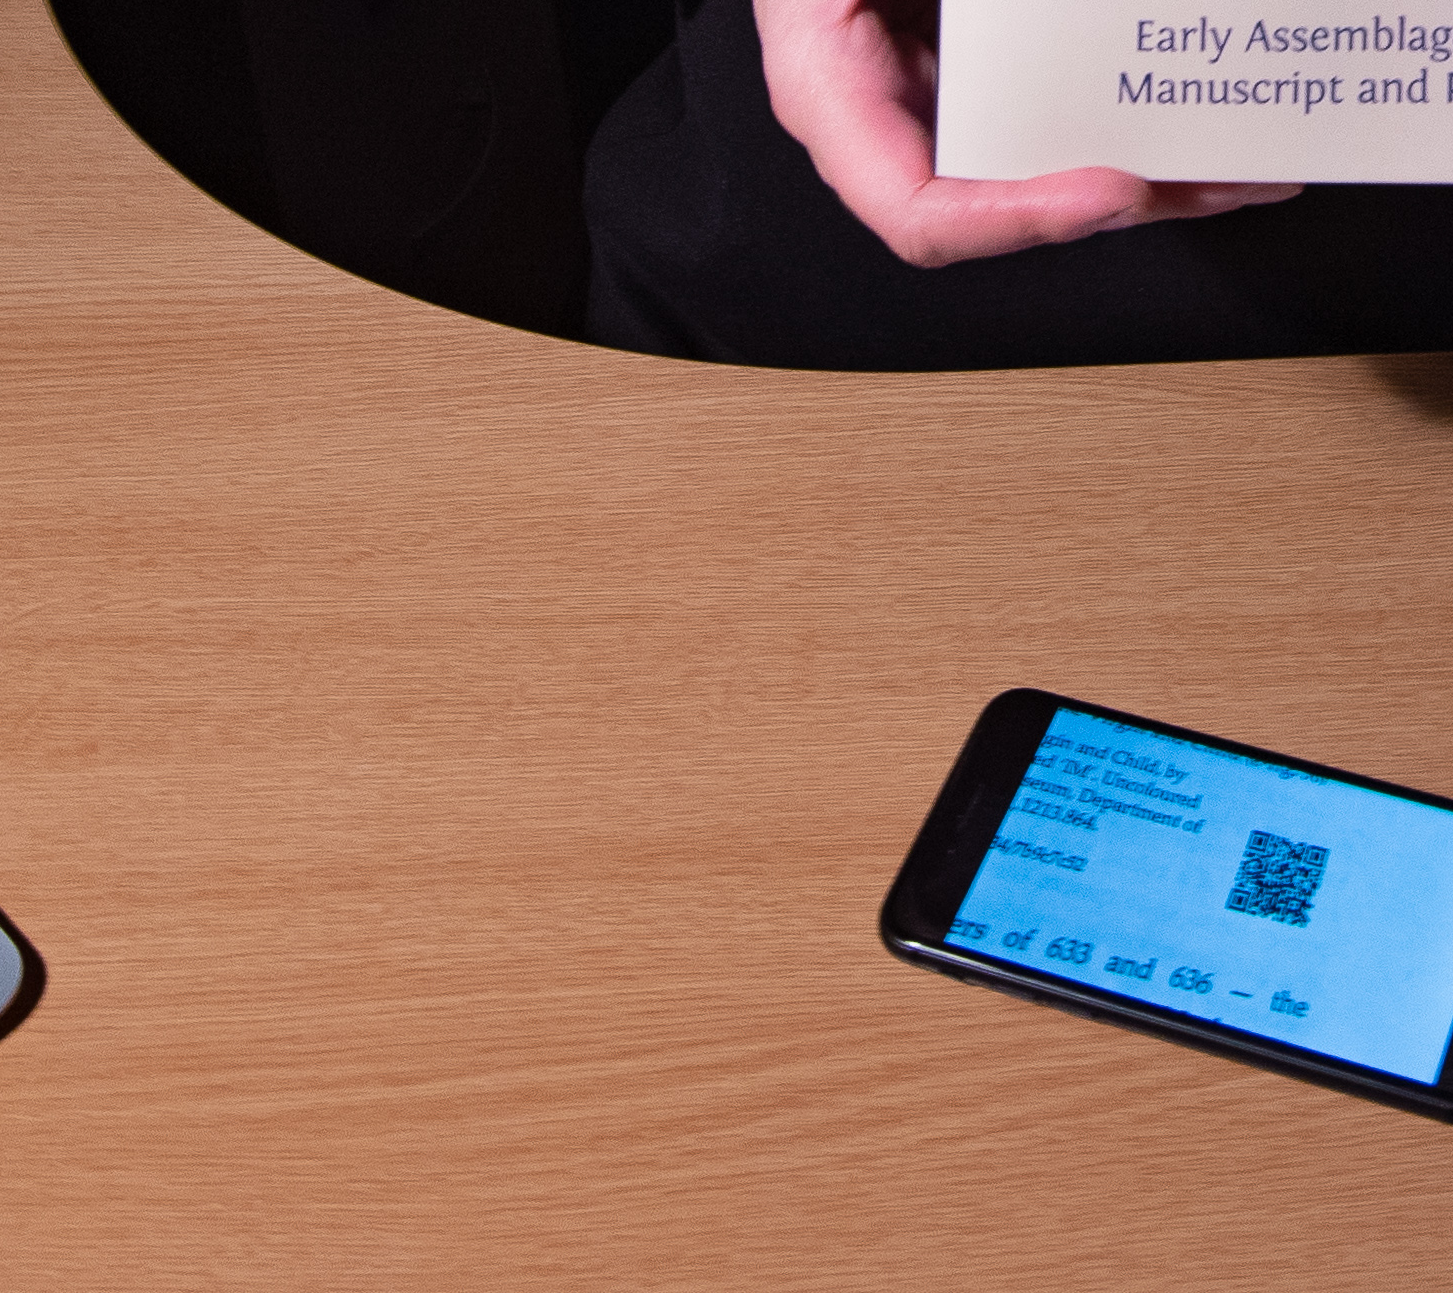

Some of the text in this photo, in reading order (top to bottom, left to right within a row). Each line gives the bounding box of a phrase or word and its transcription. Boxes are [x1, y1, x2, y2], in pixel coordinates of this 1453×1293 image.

[1135, 17, 1233, 65] Early
[1116, 71, 1345, 114] Manuscript
[1356, 68, 1430, 106] and
[1075, 742, 1109, 762] and
[1076, 786, 1182, 830] Department
[1181, 817, 1207, 835] of
[1101, 769, 1205, 811] Uncoloured
[1001, 926, 1040, 954] of
[1044, 935, 1095, 968] 633
[1102, 953, 1157, 985] and
[1168, 964, 1218, 997] 636
[1268, 987, 1312, 1020] the
